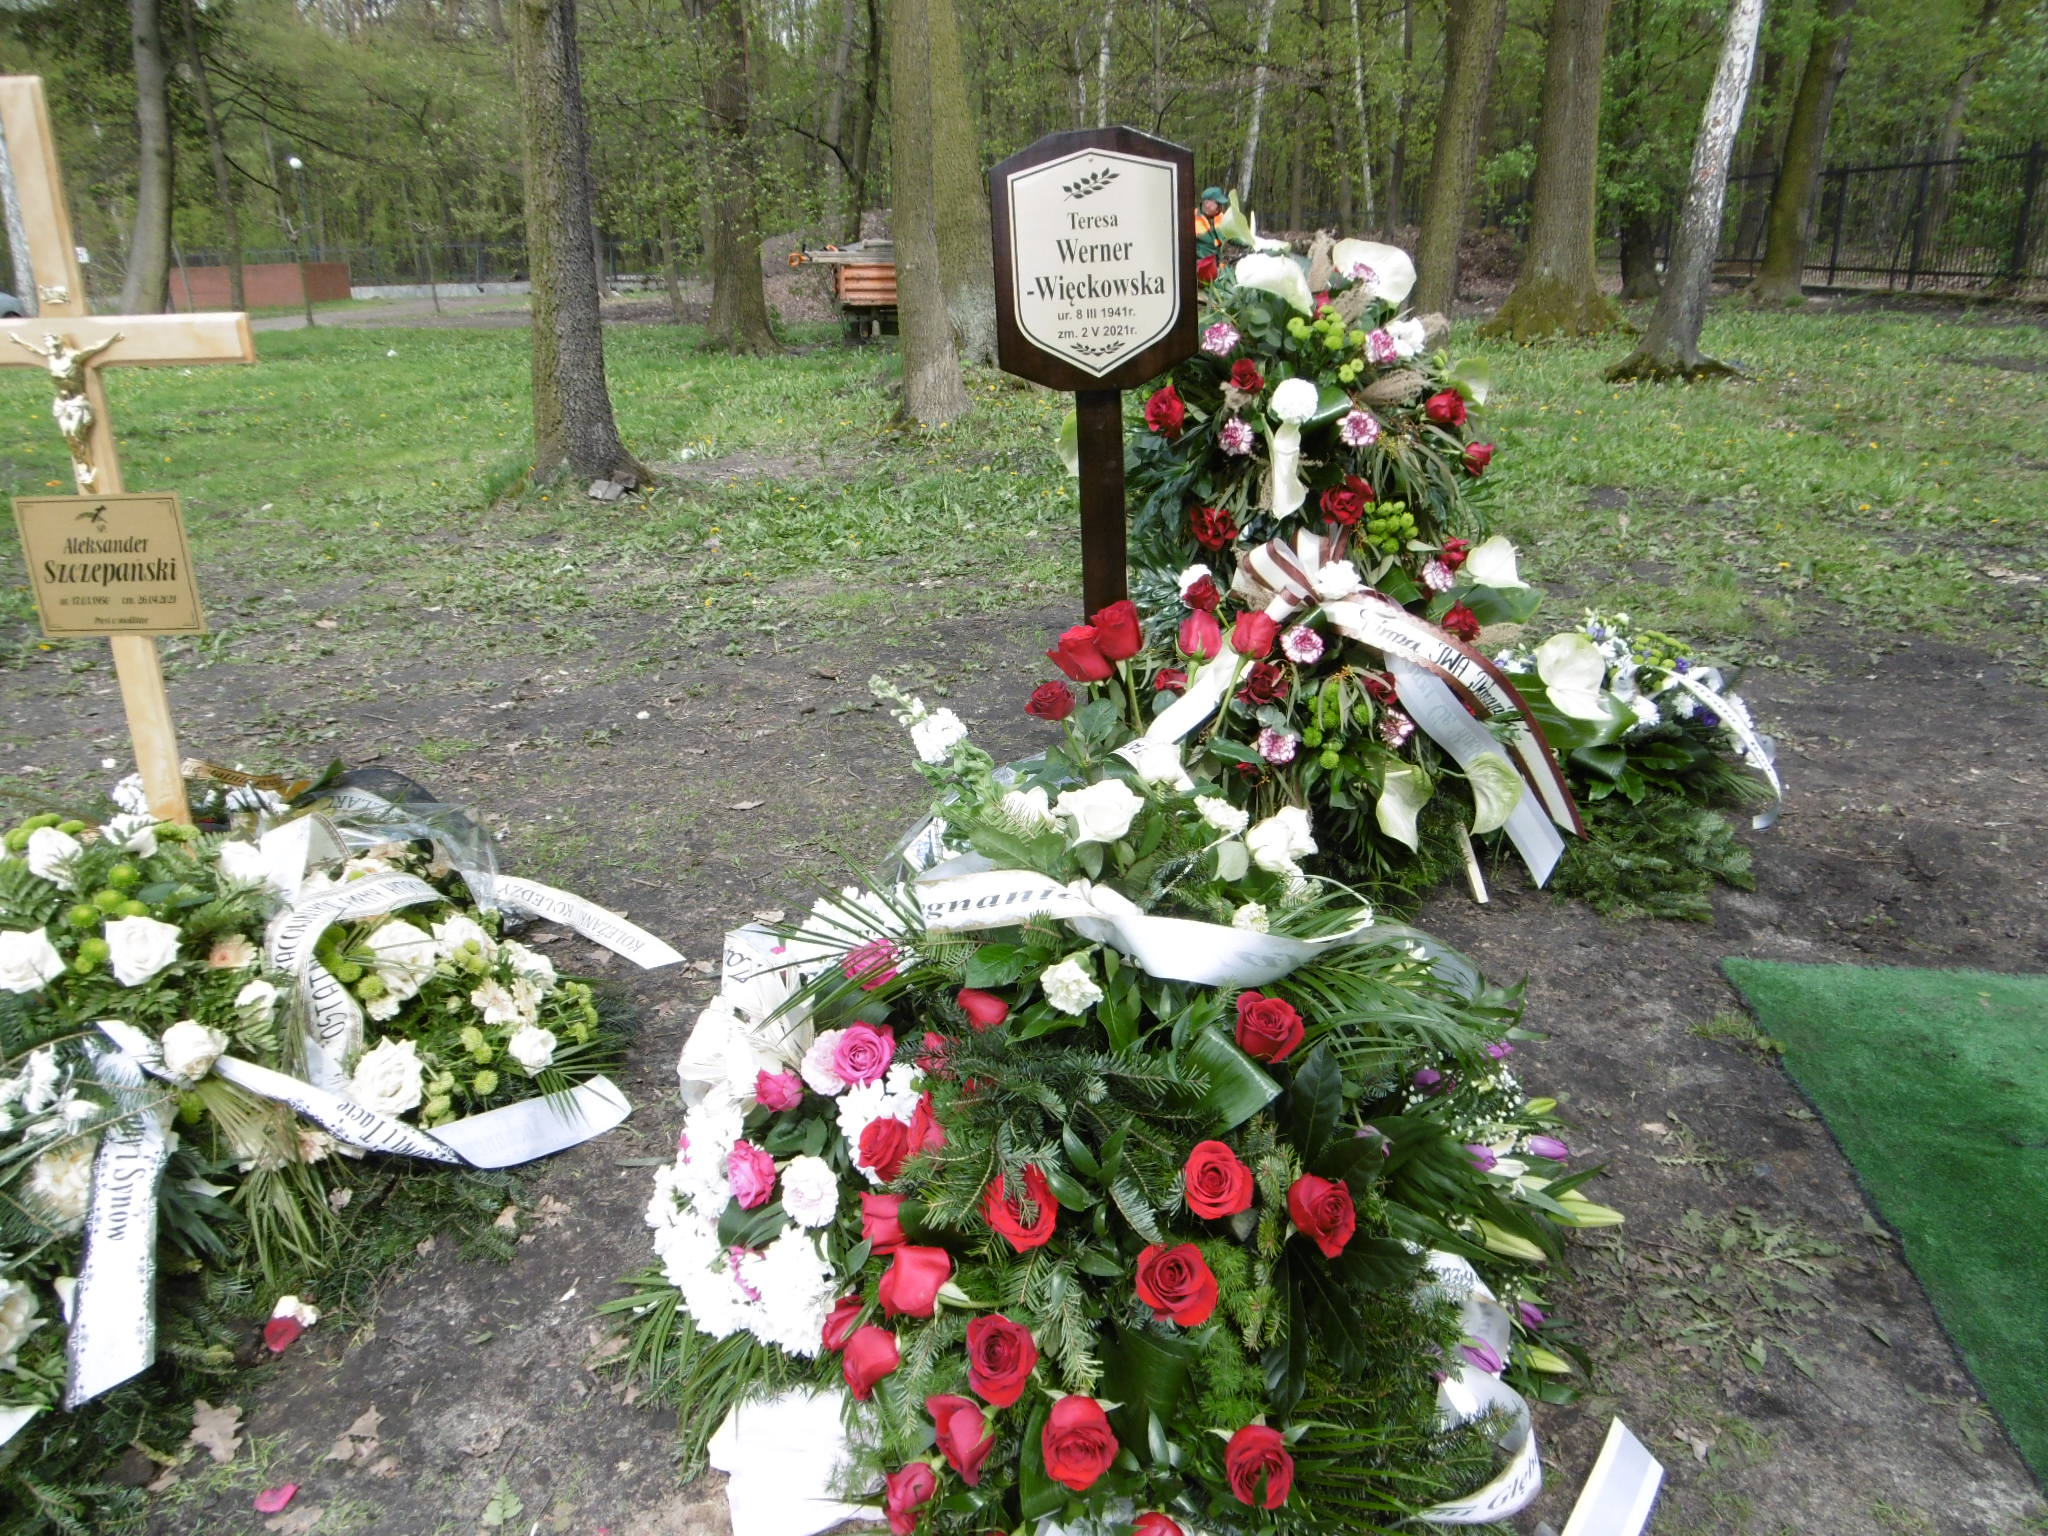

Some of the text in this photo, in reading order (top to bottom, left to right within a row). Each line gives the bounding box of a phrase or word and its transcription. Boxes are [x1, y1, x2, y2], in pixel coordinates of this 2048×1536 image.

[1067, 212, 1118, 230] Teresa
[1056, 238, 1133, 264] Werner
[1027, 271, 1165, 306] -Więckowska
[1058, 306, 1136, 320] ur. 8 III 1941r.
[1058, 325, 1137, 339] zm. 2 V 2021r.
[63, 536, 149, 554] Aleksander
[44, 557, 177, 587] Szczepański
[336, 1101, 386, 1144] Tacie
[107, 1168, 147, 1241] Synów
